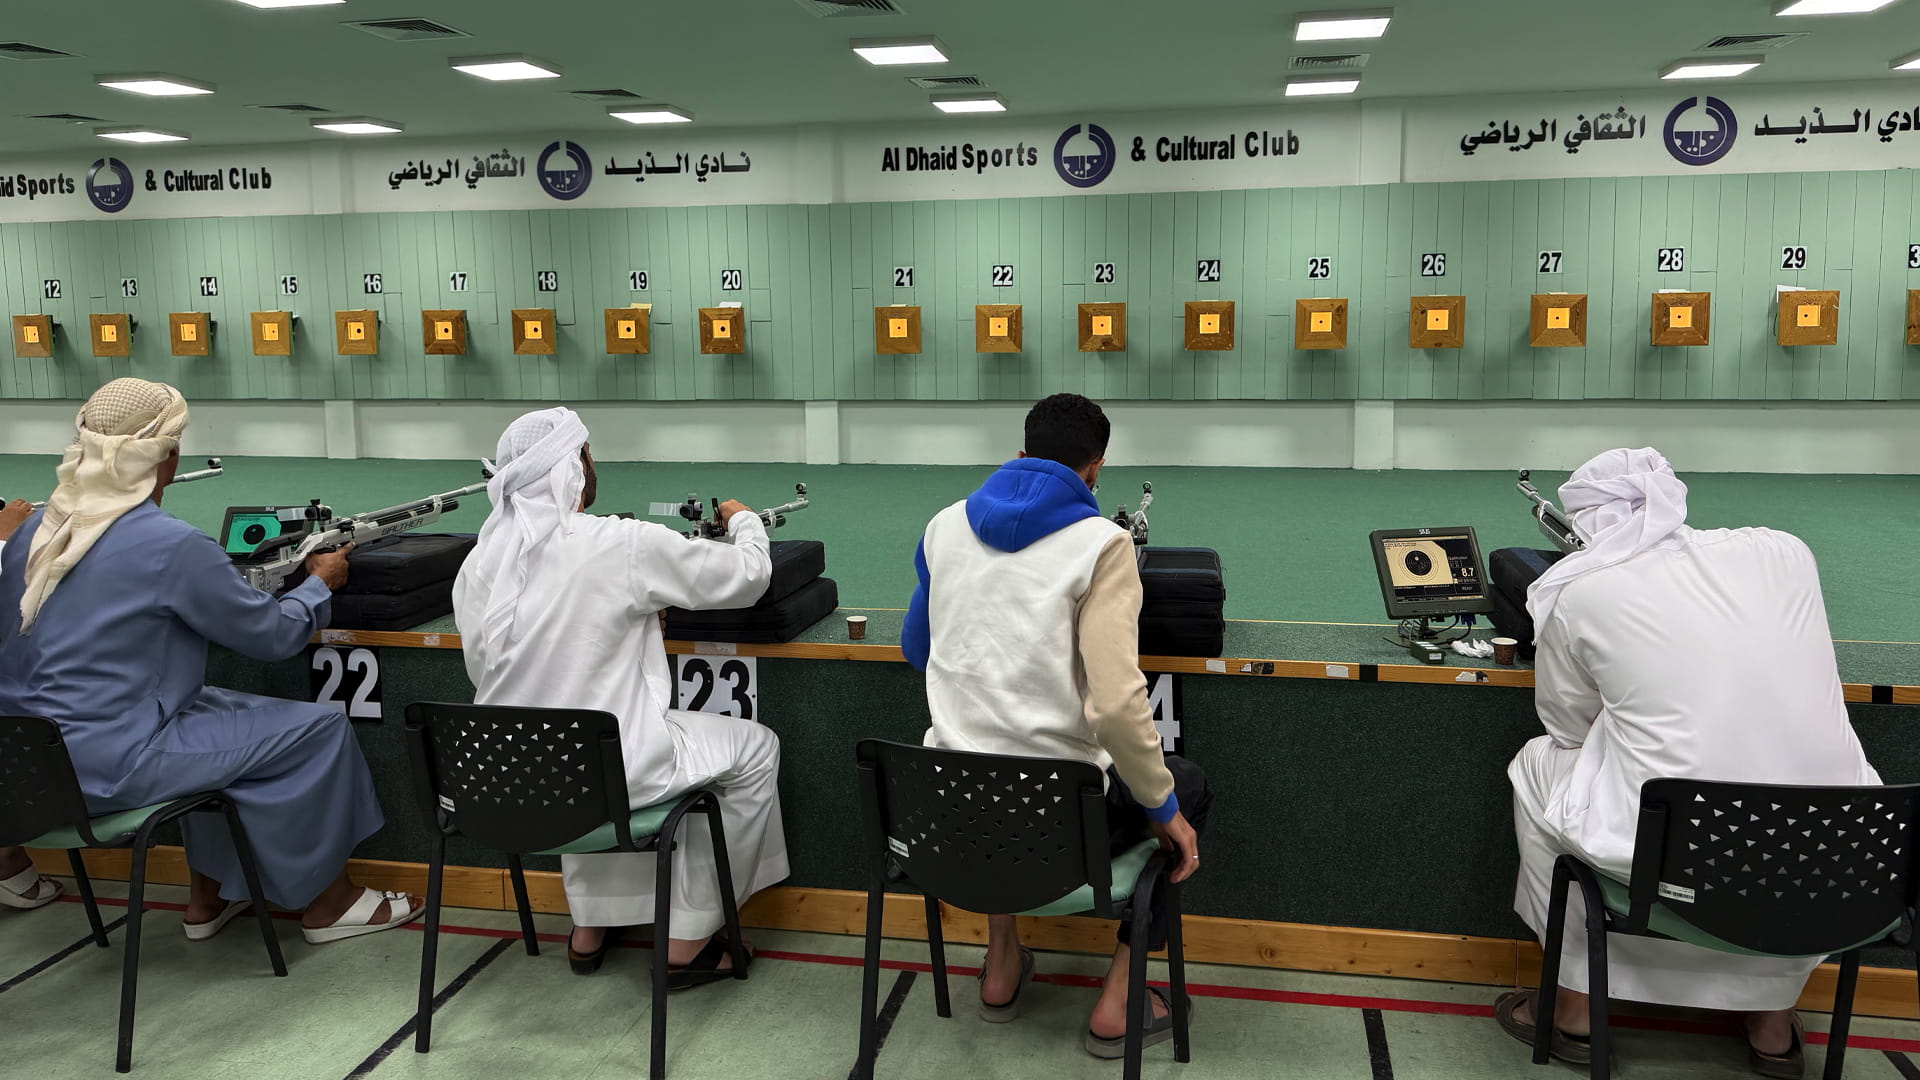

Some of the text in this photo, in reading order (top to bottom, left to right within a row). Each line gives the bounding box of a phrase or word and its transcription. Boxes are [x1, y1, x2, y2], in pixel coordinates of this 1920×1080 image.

[1460, 106, 1920, 156] ادي الذيد الثقافي الرياضي
[881, 129, 1299, 174] Al Dhaid Sports & Cultural Club
[388, 148, 751, 190] نادي الذيد الثقافي الرياضي
[17, 172, 75, 200] Sports
[145, 169, 157, 192] &
[164, 168, 223, 192] Cultural
[228, 167, 272, 190] Club
[1423, 254, 1445, 275] 26
[1540, 252, 1562, 273] 27
[1659, 249, 1683, 271] 28
[1782, 247, 1806, 268] 29
[1910, 245, 1920, 267] 3
[895, 268, 913, 287] 21
[993, 266, 1013, 285] 22
[1095, 264, 1114, 283] 23
[1199, 261, 1219, 281] 24
[1308, 258, 1329, 278] 25
[122, 280, 137, 297] 13
[201, 278, 217, 296] 14
[281, 276, 298, 294] 15
[364, 274, 381, 293] 16
[450, 273, 467, 291] 17
[539, 272, 556, 290] 18
[630, 271, 648, 289] 19
[722, 270, 741, 289] 20
[45, 281, 61, 298] 12
[381, 518, 424, 536] WALTHER
[1461, 567, 1474, 577] 8.7
[312, 647, 382, 718] 22
[682, 658, 753, 720] 23
[1149, 673, 1181, 752] 4
